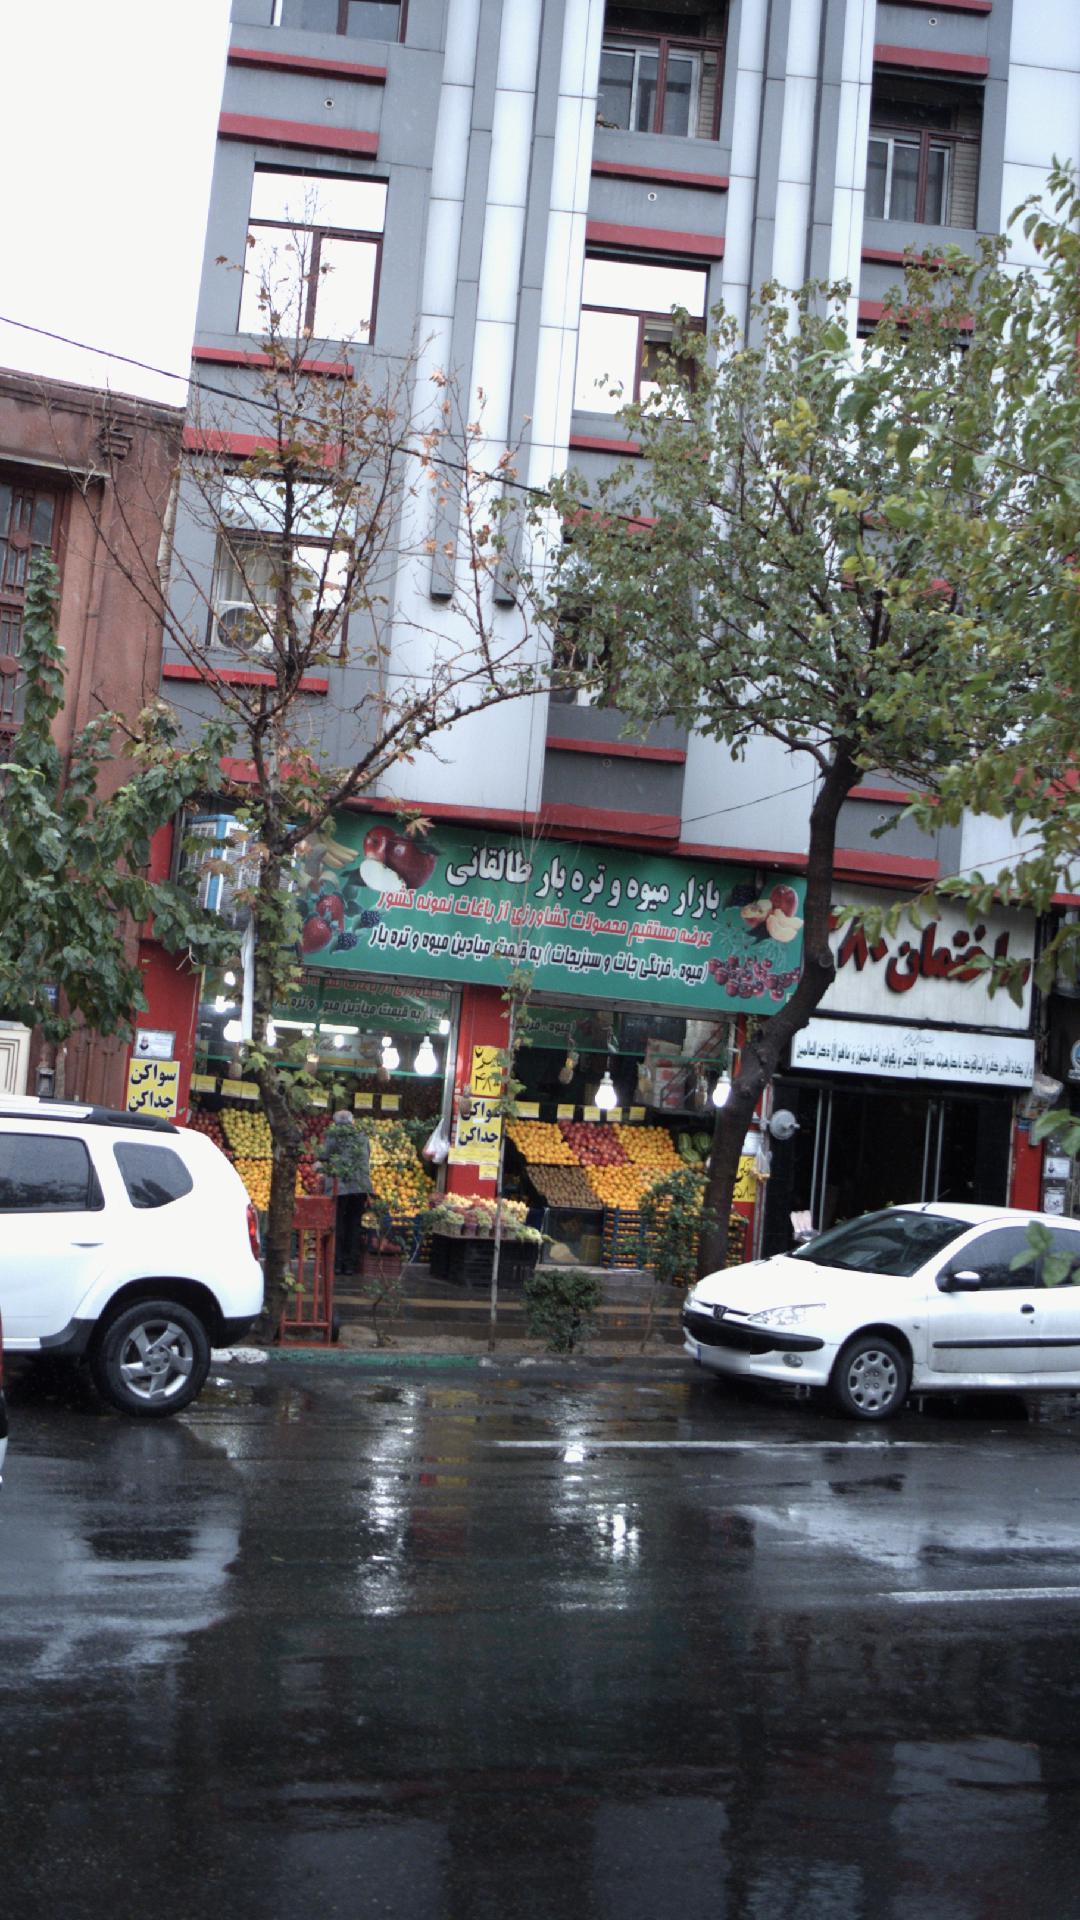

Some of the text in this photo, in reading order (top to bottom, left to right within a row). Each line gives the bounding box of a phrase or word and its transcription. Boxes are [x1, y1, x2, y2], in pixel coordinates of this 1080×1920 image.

[445, 846, 721, 920] بازار میوه و تره بار طالقانی
[376, 884, 712, 947] عرضه مستقیم محصولات کشاورزی از باغات نمونه کشور
[369, 922, 388, 946] بار
[391, 925, 410, 948] تره
[411, 932, 420, 950] و
[421, 932, 450, 957] میوه
[451, 936, 491, 961] میادین
[529, 947, 543, 968] به
[603, 957, 611, 972] و
[322, 1000, 341, 1014] میو
